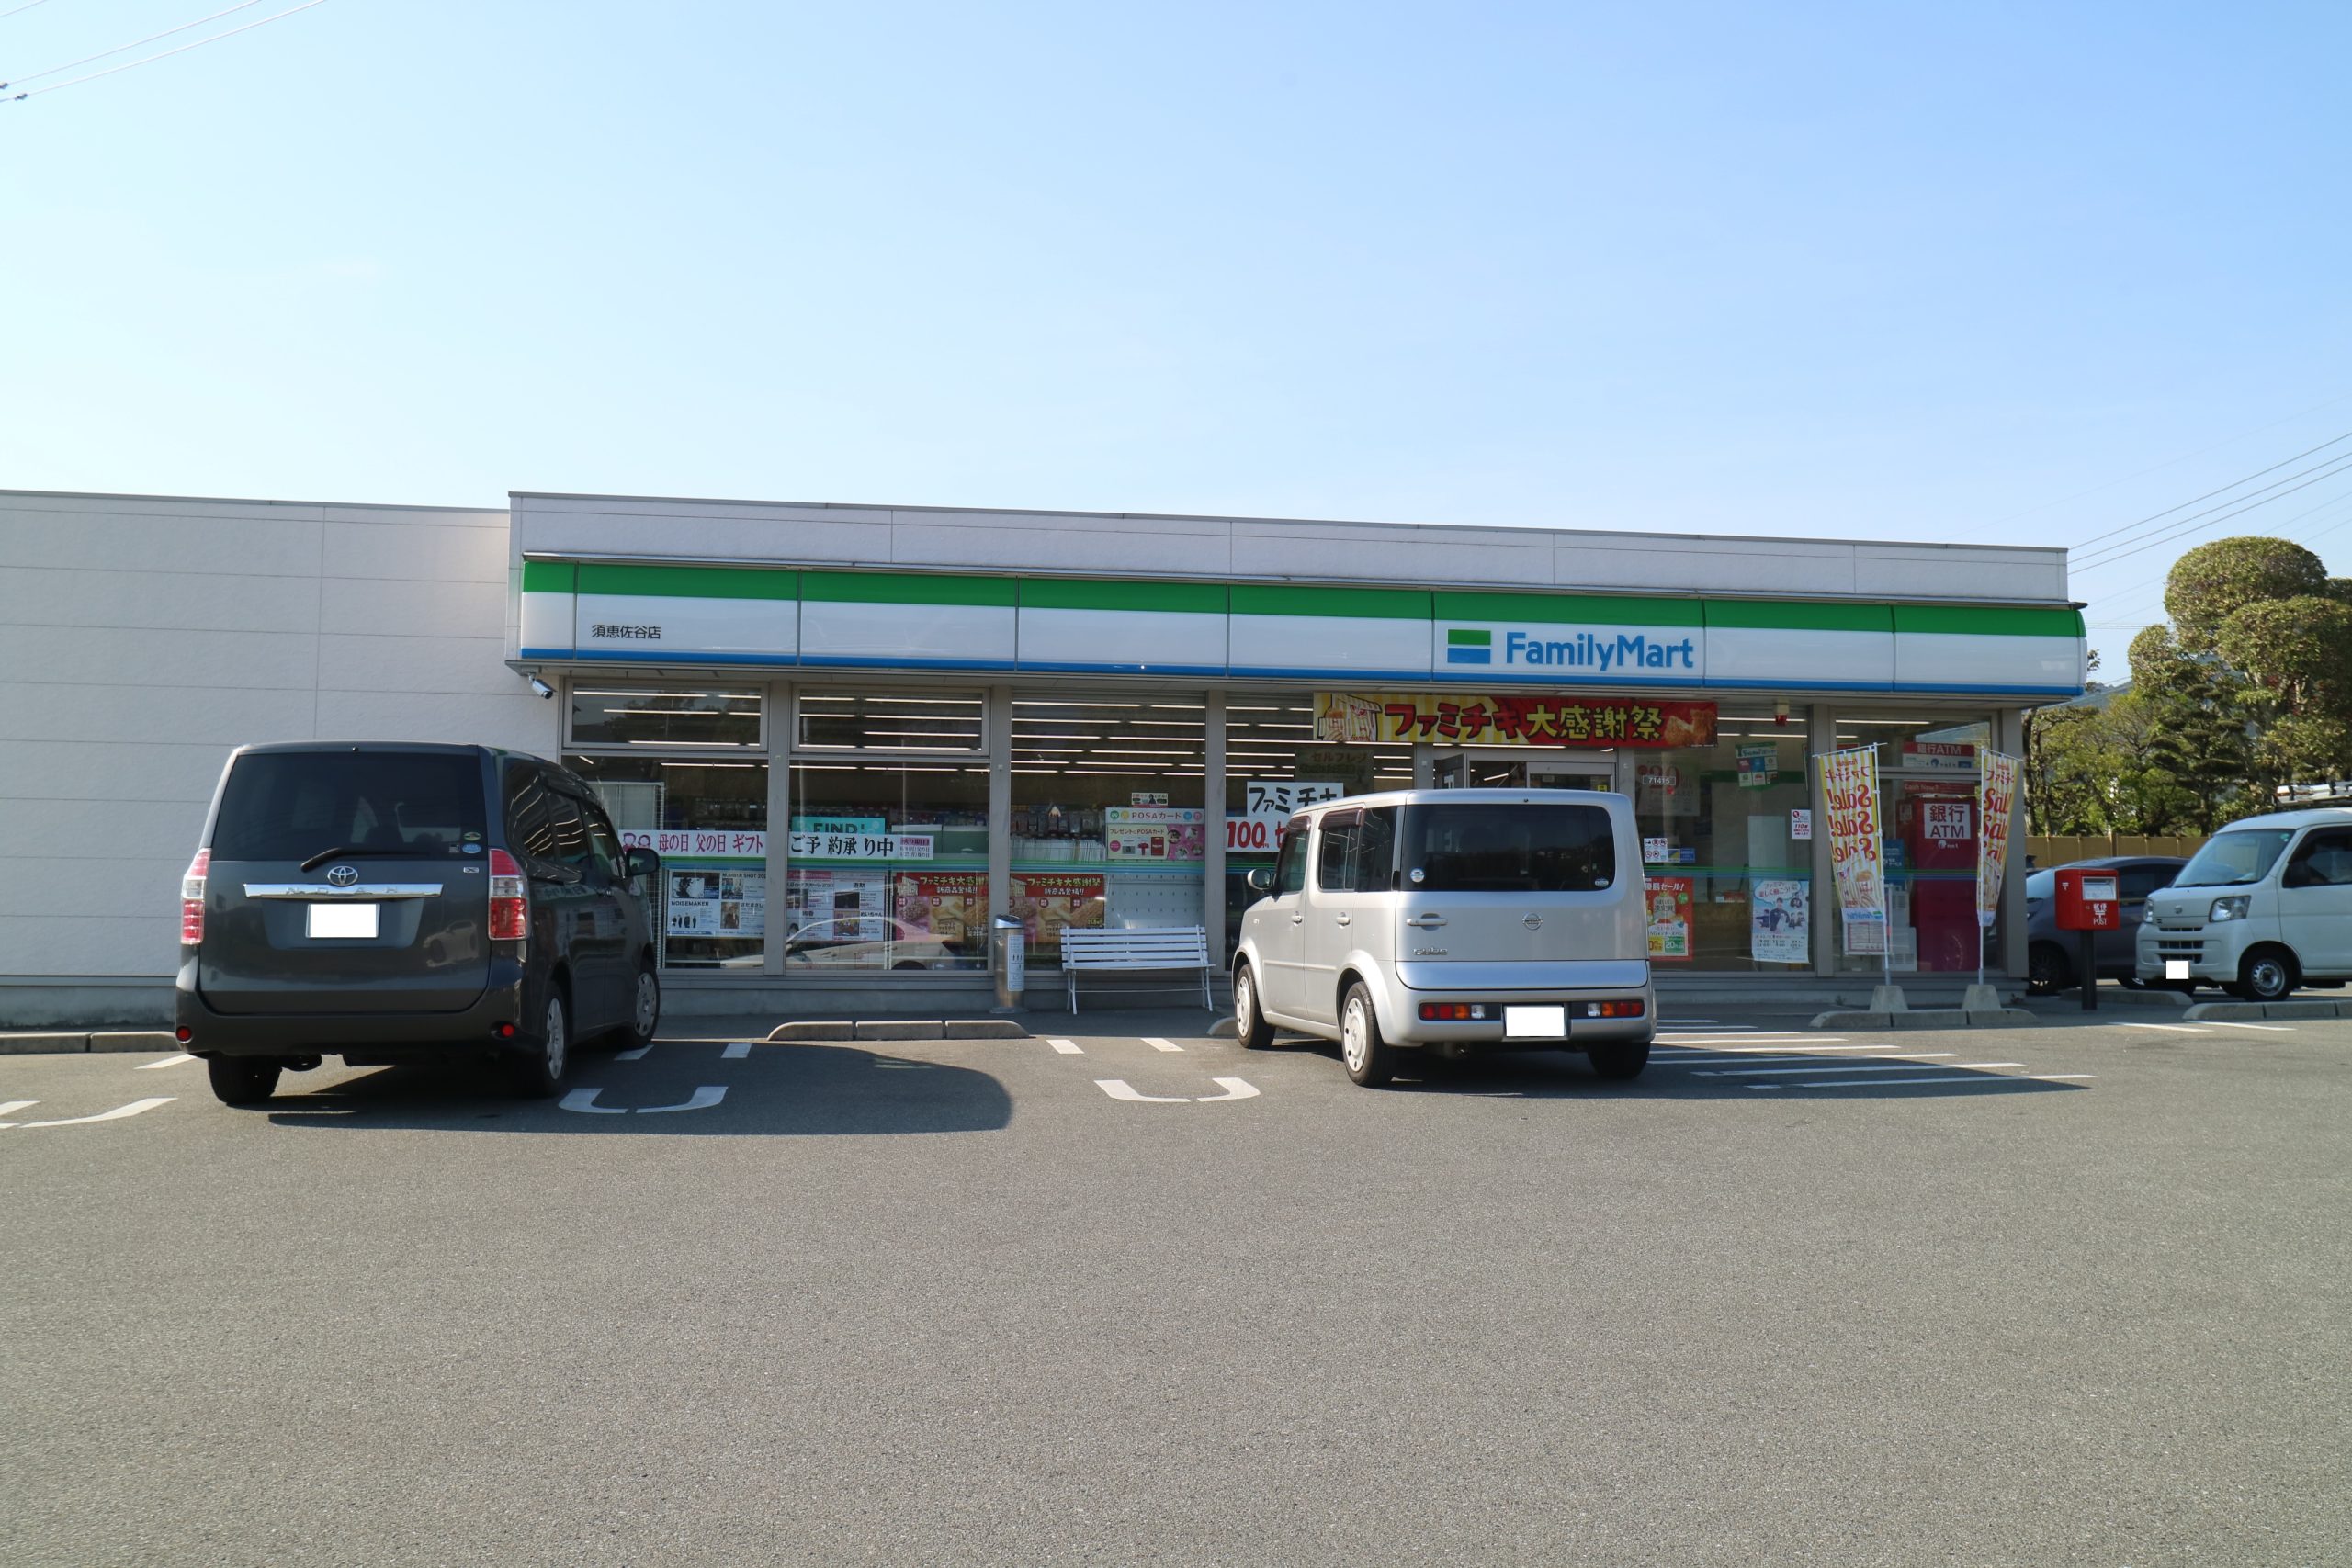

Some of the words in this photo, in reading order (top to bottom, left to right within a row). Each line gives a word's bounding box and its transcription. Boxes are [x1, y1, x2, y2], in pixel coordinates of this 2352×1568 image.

[592, 625, 661, 639] 須恵佐谷店
[1506, 632, 1694, 671] FamilyMart
[1385, 702, 1662, 741] ファミチキ大感謝祭
[1132, 812, 1182, 820] POSAカード
[1930, 805, 1965, 822] 銀行
[1930, 825, 1964, 838] ATM
[659, 833, 689, 852] 母の日
[695, 834, 726, 853] 父の日
[732, 834, 763, 854] ギフト
[1027, 877, 1101, 886] ファミチキ大感謝祭
